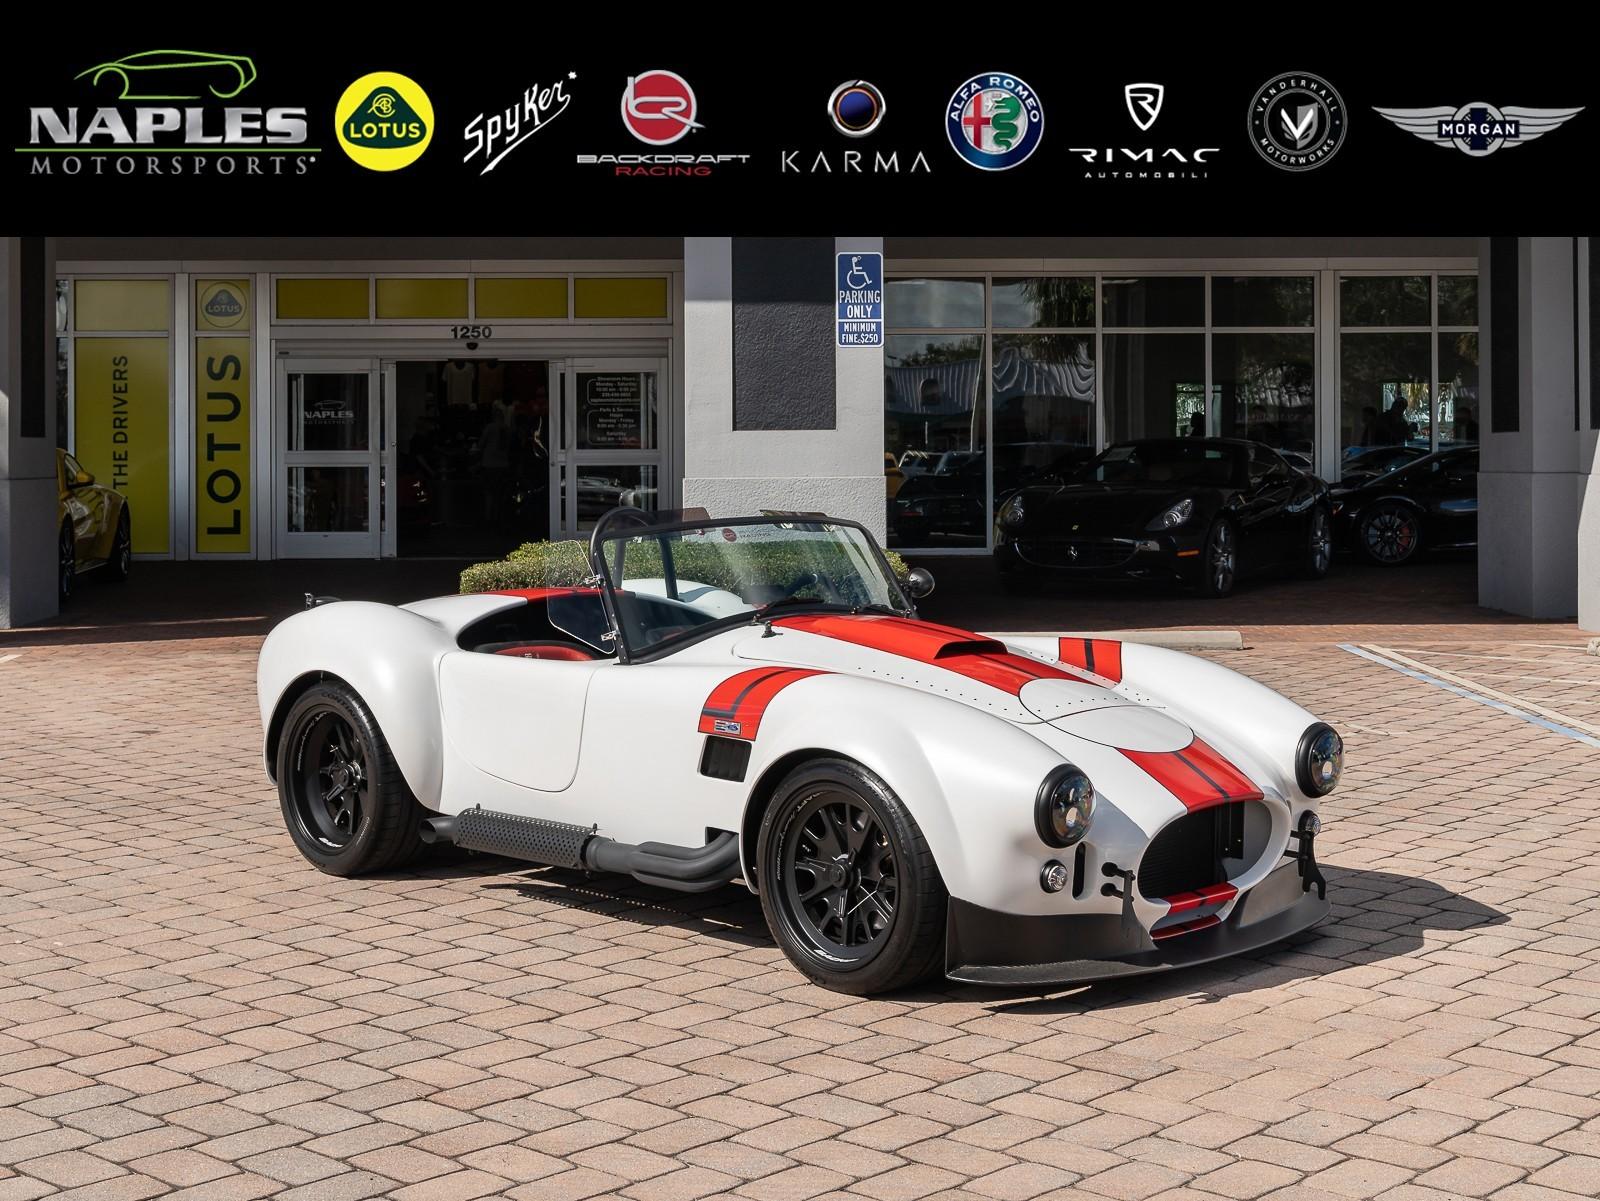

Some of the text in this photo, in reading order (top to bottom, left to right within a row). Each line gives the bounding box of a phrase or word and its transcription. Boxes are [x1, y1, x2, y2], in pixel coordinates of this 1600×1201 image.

[839, 290, 881, 303] PARKING
[207, 304, 240, 313] LOTUS
[846, 305, 873, 318] ONLY
[451, 326, 492, 339] 1250
[843, 322, 877, 332] MINIMUM
[841, 333, 878, 344] FINE $250
[303, 410, 355, 419] NAPLES
[112, 355, 129, 490] THE DRIVERS
[206, 354, 242, 535] LOTUS
